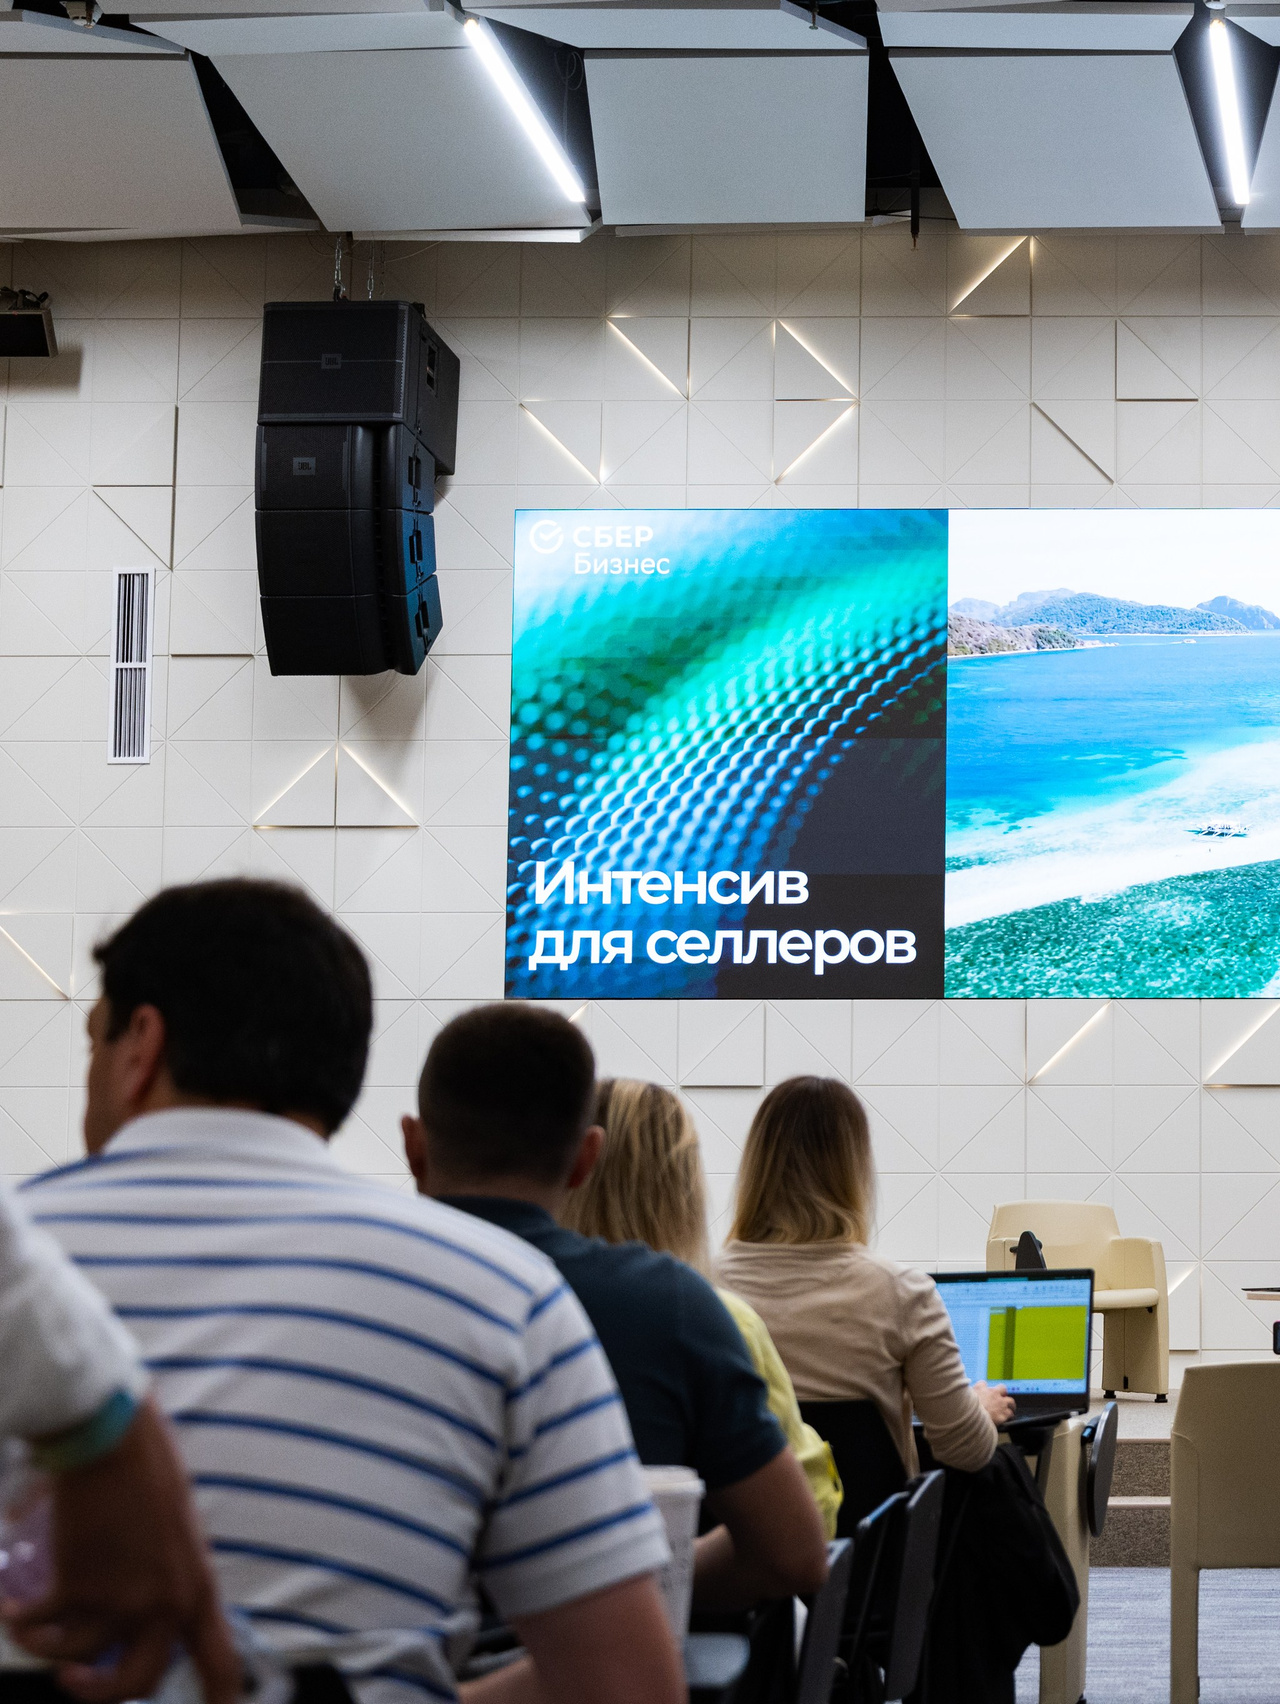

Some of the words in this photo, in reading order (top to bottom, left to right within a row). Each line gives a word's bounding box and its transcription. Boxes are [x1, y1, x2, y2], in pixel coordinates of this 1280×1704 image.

[573, 525, 654, 548] СБЕР
[574, 552, 670, 575] Бизнес
[535, 861, 809, 905] Интенсив
[528, 929, 633, 971] для
[646, 928, 917, 975] селлеров
